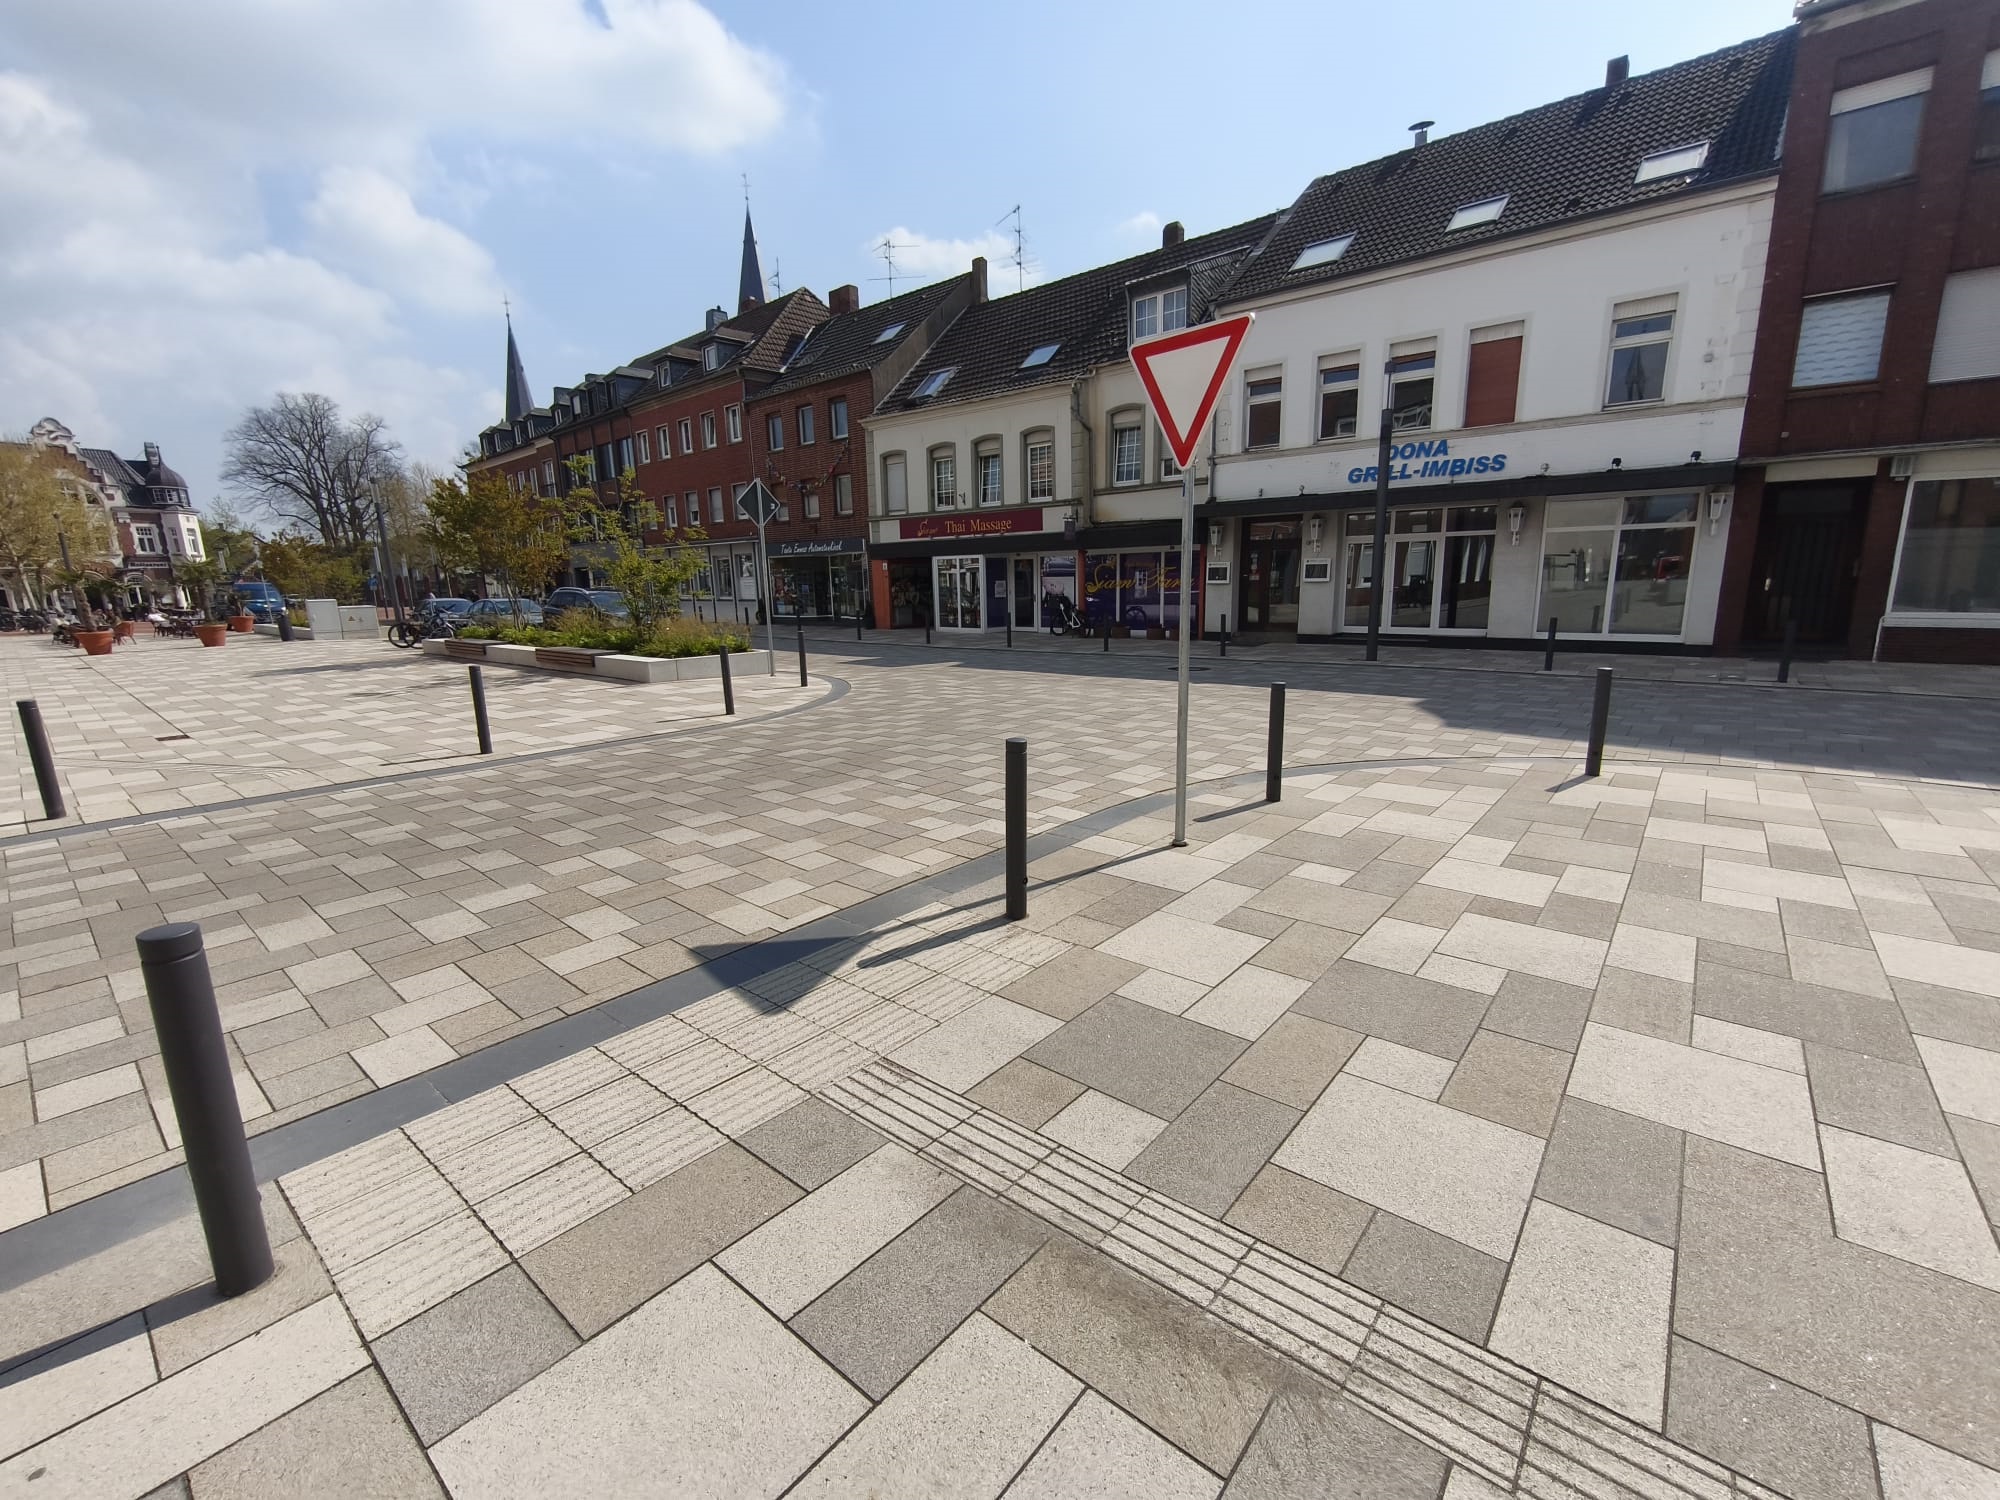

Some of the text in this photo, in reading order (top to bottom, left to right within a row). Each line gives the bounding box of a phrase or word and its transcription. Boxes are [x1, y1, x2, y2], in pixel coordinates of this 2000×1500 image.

[1348, 454, 1507, 484] GRLL-IMBISS
[944, 520, 966, 533] Thai
[970, 518, 1012, 532] Massage
